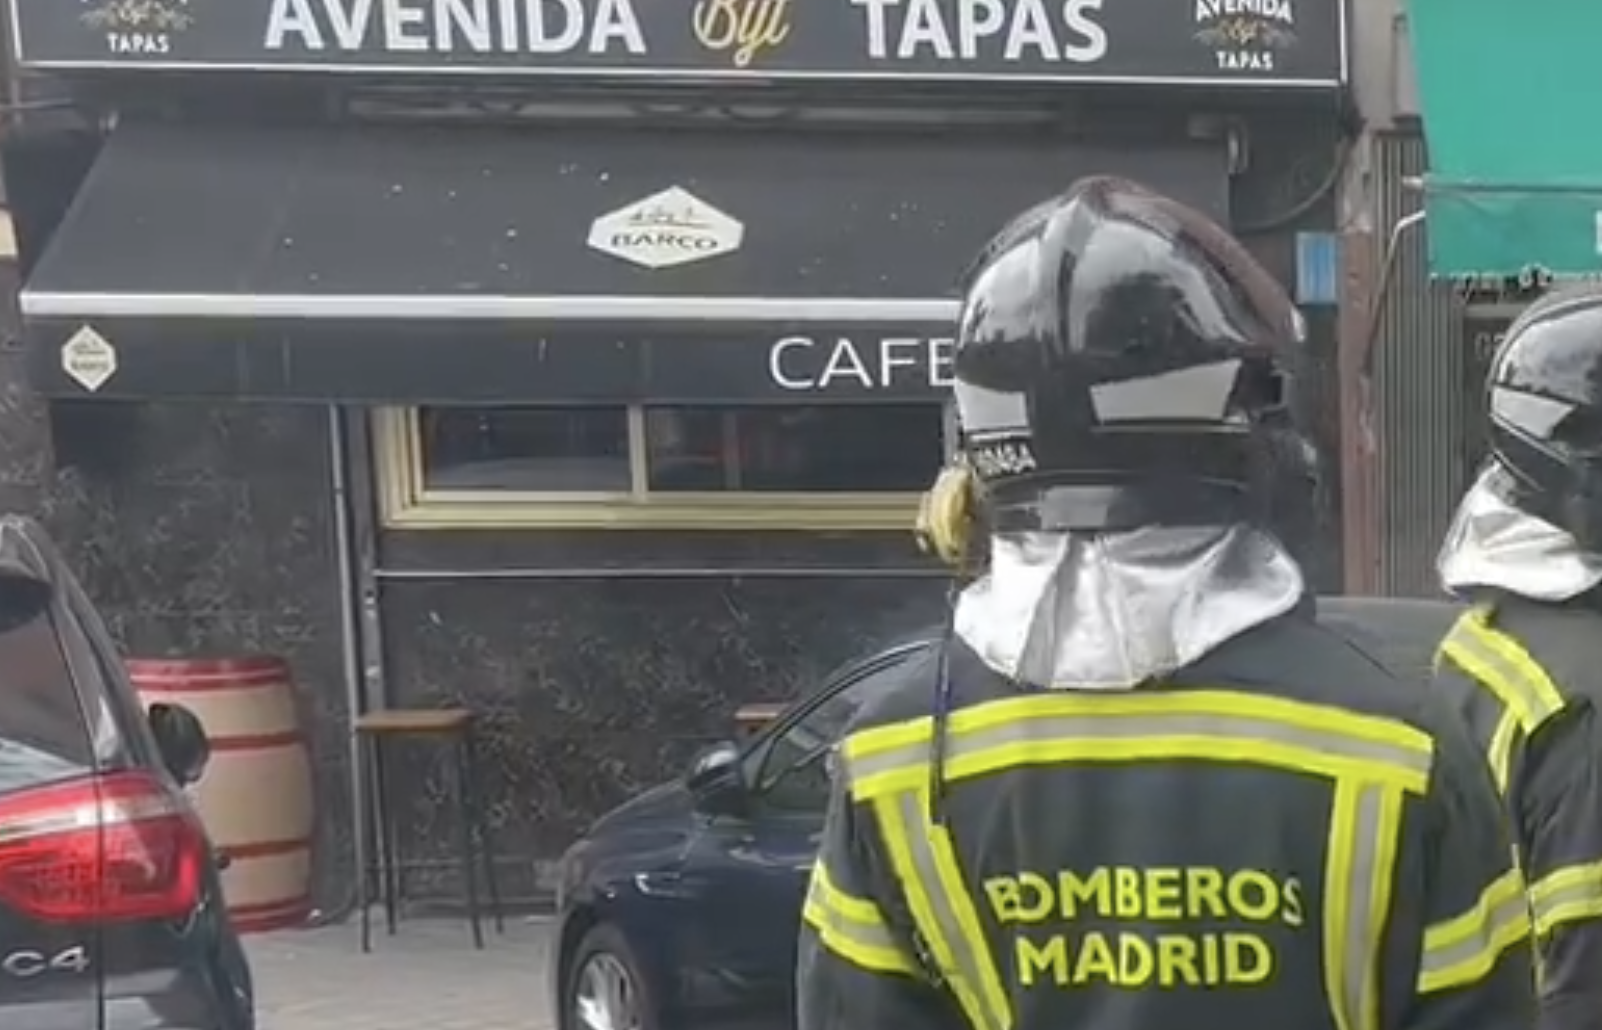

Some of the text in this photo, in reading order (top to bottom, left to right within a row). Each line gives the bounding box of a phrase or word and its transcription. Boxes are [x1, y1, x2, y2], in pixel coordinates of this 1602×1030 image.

[107, 32, 170, 52] TAPAS
[264, 0, 647, 53] AVENIDA
[850, 0, 1109, 61] TAPAS
[1216, 50, 1274, 70] TAPAS
[610, 232, 719, 249] BARCO
[984, 865, 1303, 926] BOMBEROS
[1014, 931, 1272, 986] MADRID
